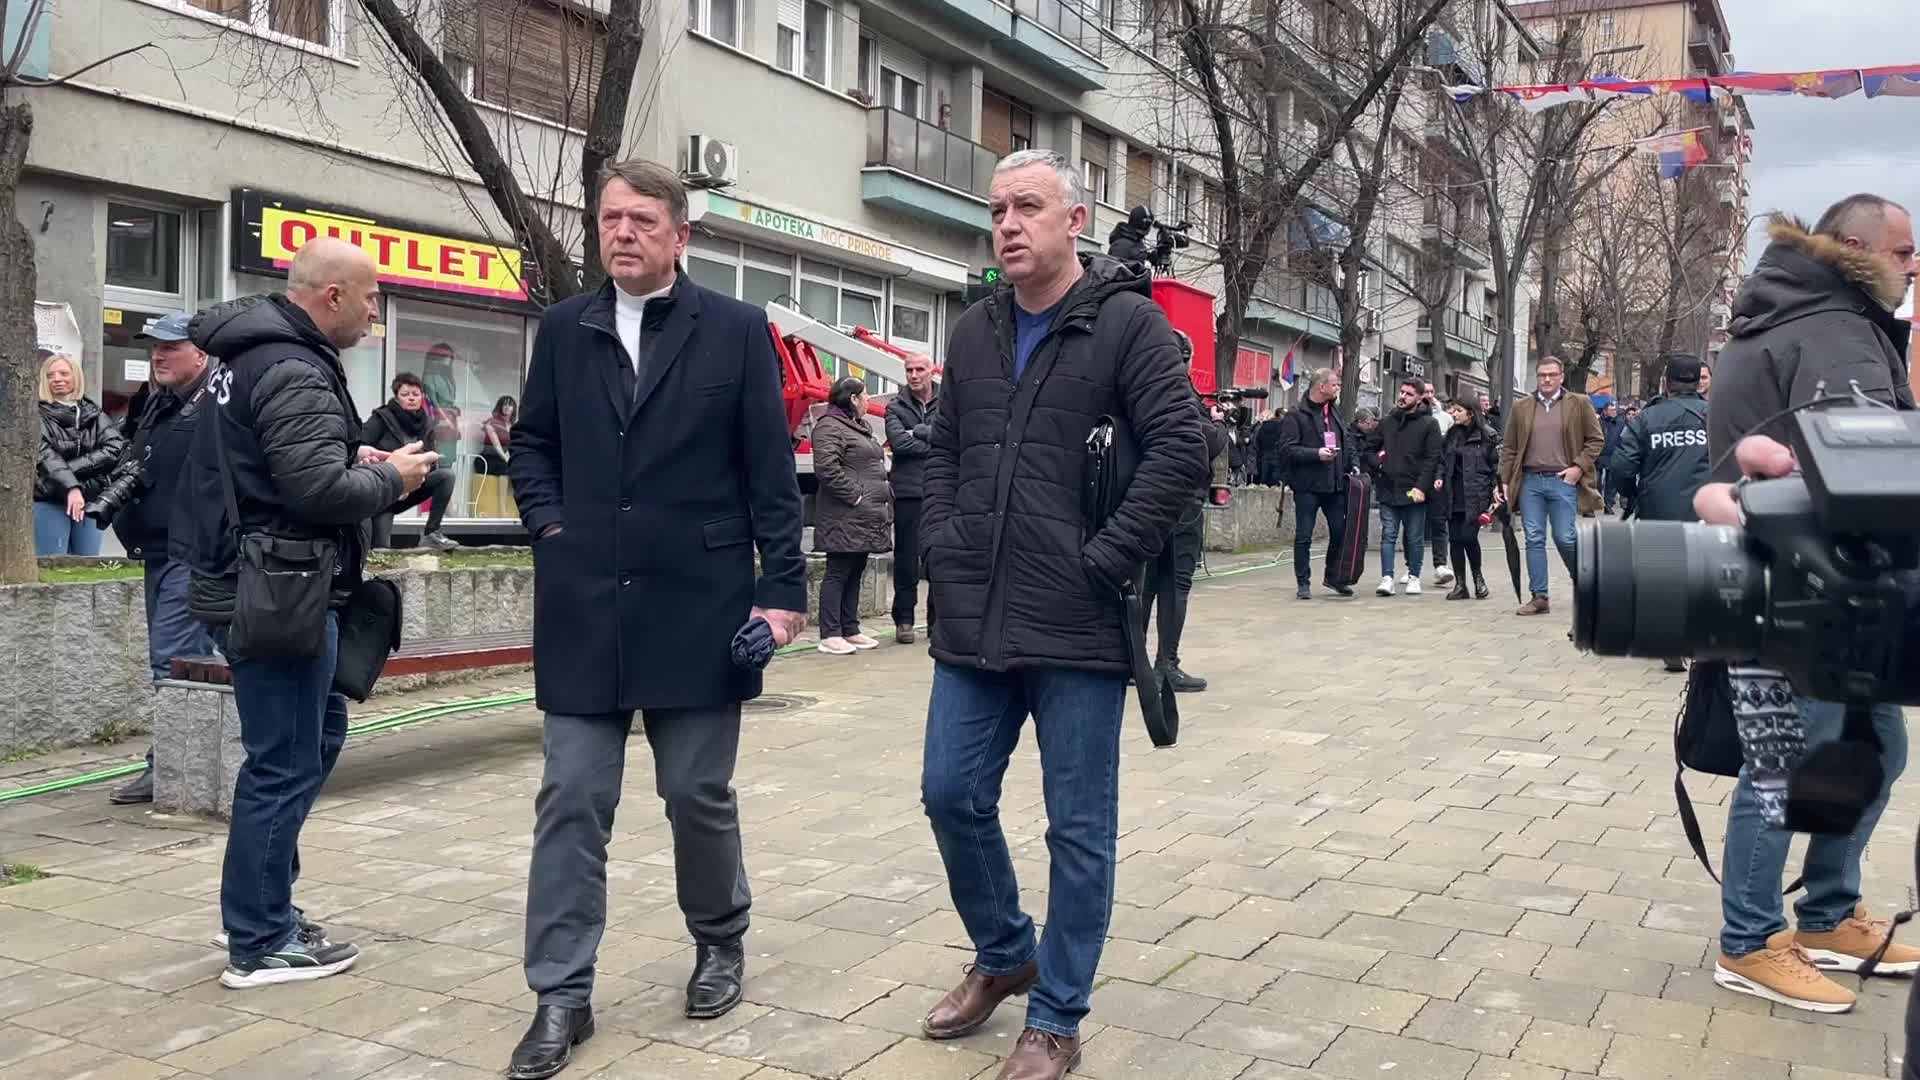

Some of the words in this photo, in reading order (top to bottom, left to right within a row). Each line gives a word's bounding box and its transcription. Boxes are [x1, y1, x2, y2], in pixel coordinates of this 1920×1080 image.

[755, 210, 815, 239] APOTEKA
[847, 236, 893, 260] PRIRODE
[1650, 429, 1708, 449] PRESS
